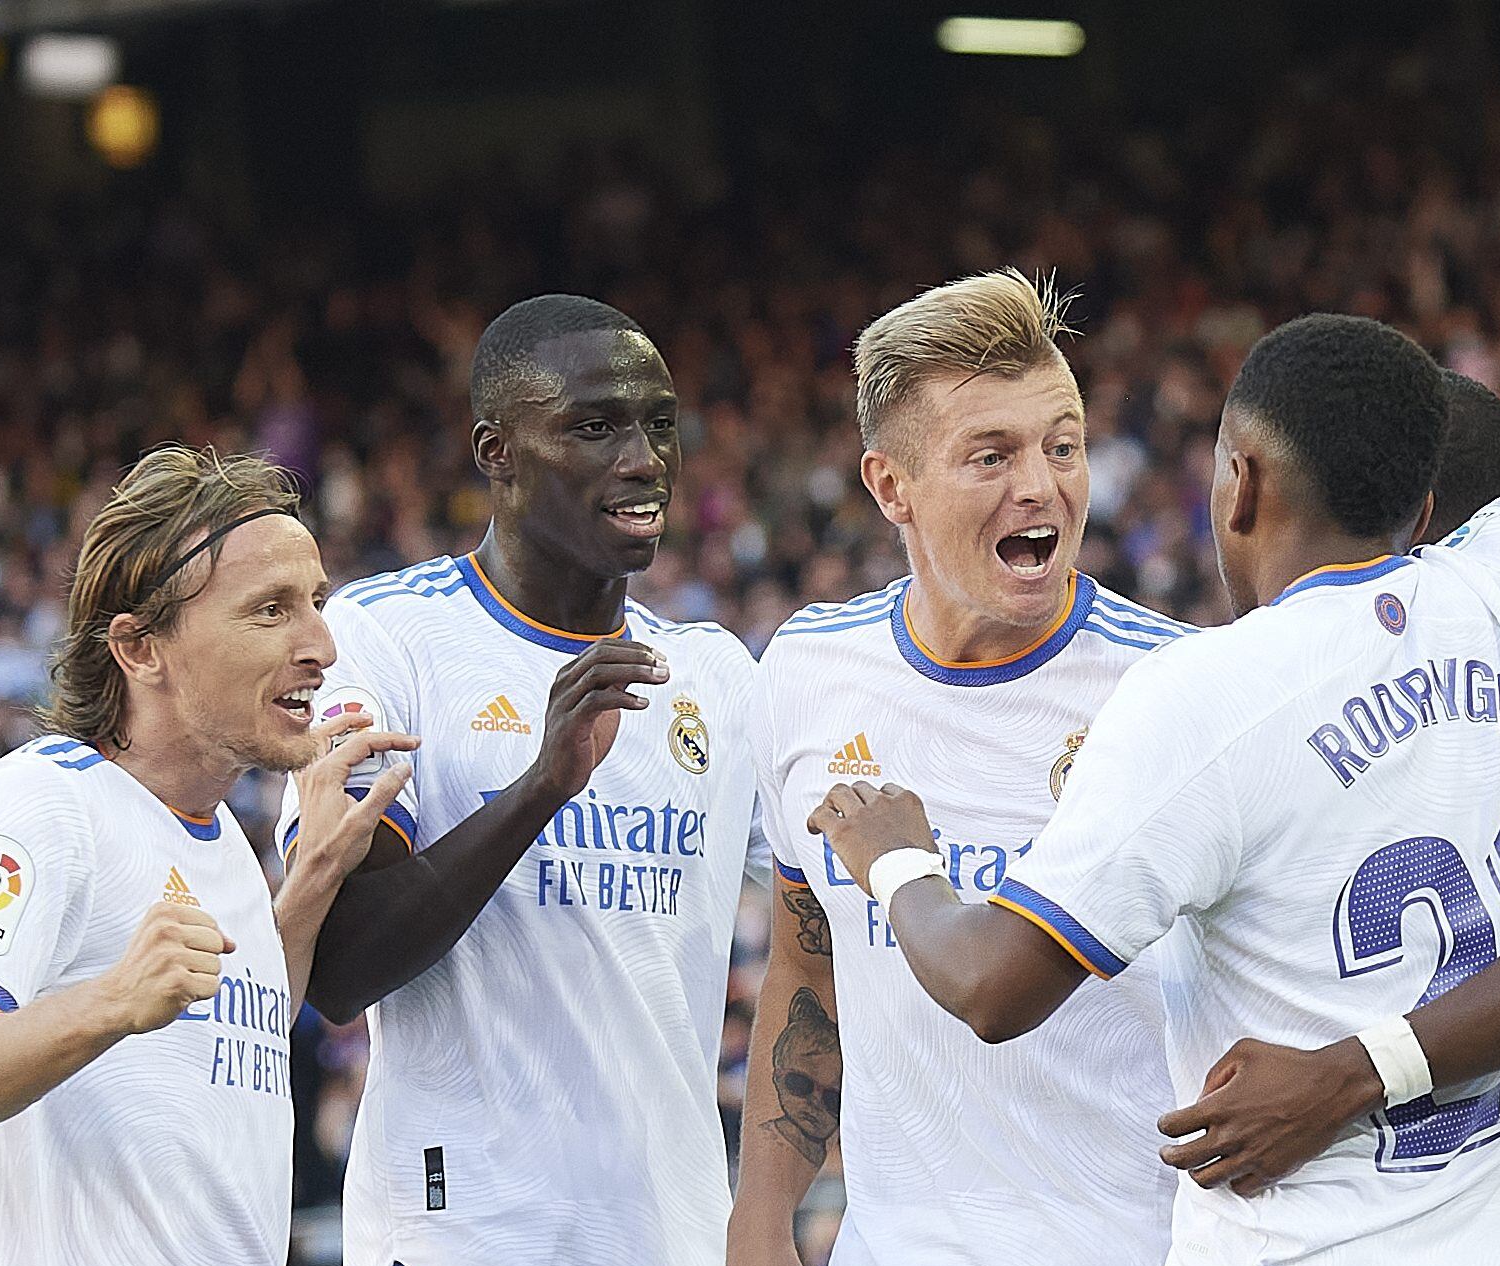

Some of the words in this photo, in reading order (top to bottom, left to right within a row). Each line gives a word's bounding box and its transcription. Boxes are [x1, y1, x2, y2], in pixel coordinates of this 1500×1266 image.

[471, 713, 532, 735] adidas
[828, 759, 882, 777] adidas
[479, 788, 707, 858] mirates
[538, 859, 588, 906] FLY
[599, 862, 682, 916] BETTER
[867, 901, 897, 948] FL
[178, 967, 290, 1040] mirat
[210, 1036, 245, 1089] FLY
